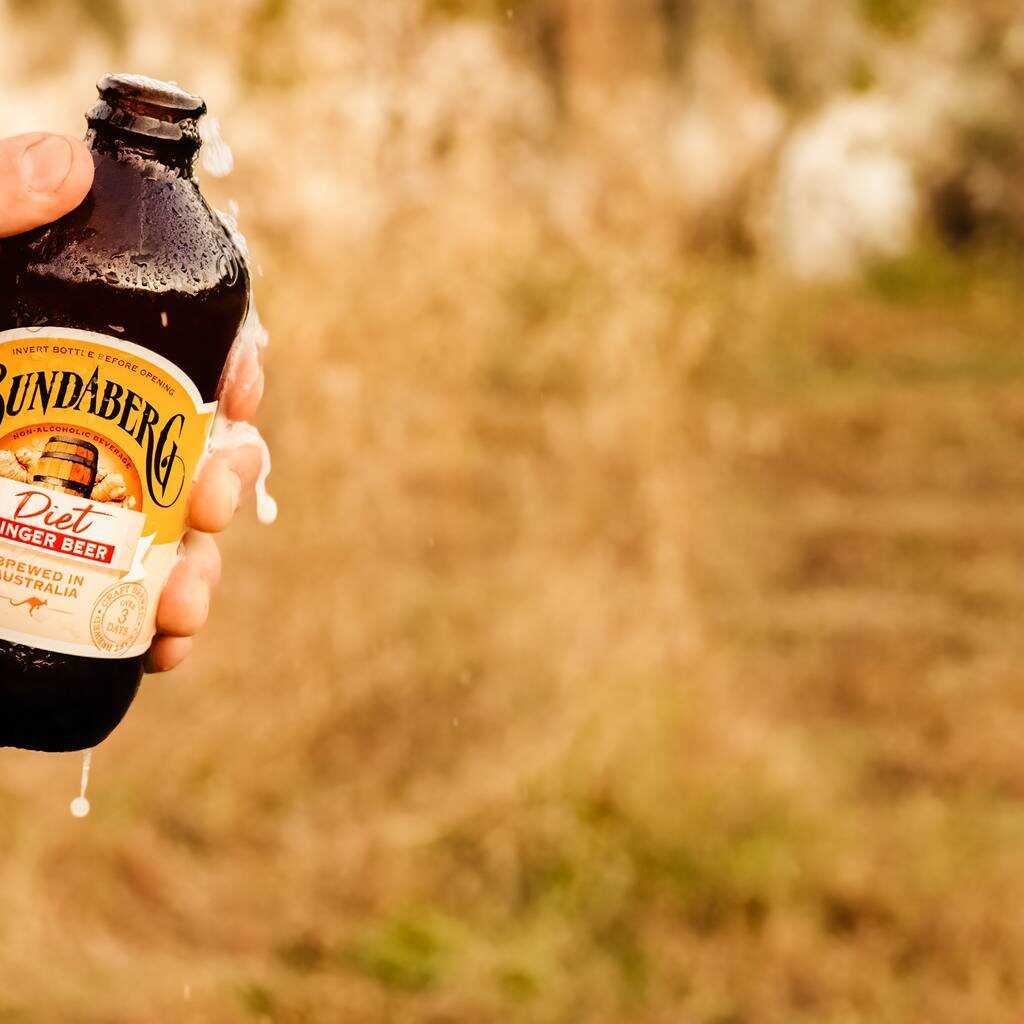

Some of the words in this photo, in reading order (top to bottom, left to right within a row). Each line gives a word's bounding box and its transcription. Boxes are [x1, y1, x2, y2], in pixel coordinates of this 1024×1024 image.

[12, 345, 49, 356] INVERT
[140, 369, 176, 396] OPENING
[13, 426, 91, 440] NON-ALCOHOLIC
[92, 435, 132, 470] BEVERAGE
[13, 490, 114, 534] Diet
[61, 537, 109, 560] BEER
[68, 574, 85, 587] IN
[118, 608, 129, 625] 3
[106, 622, 129, 636] DAYS
